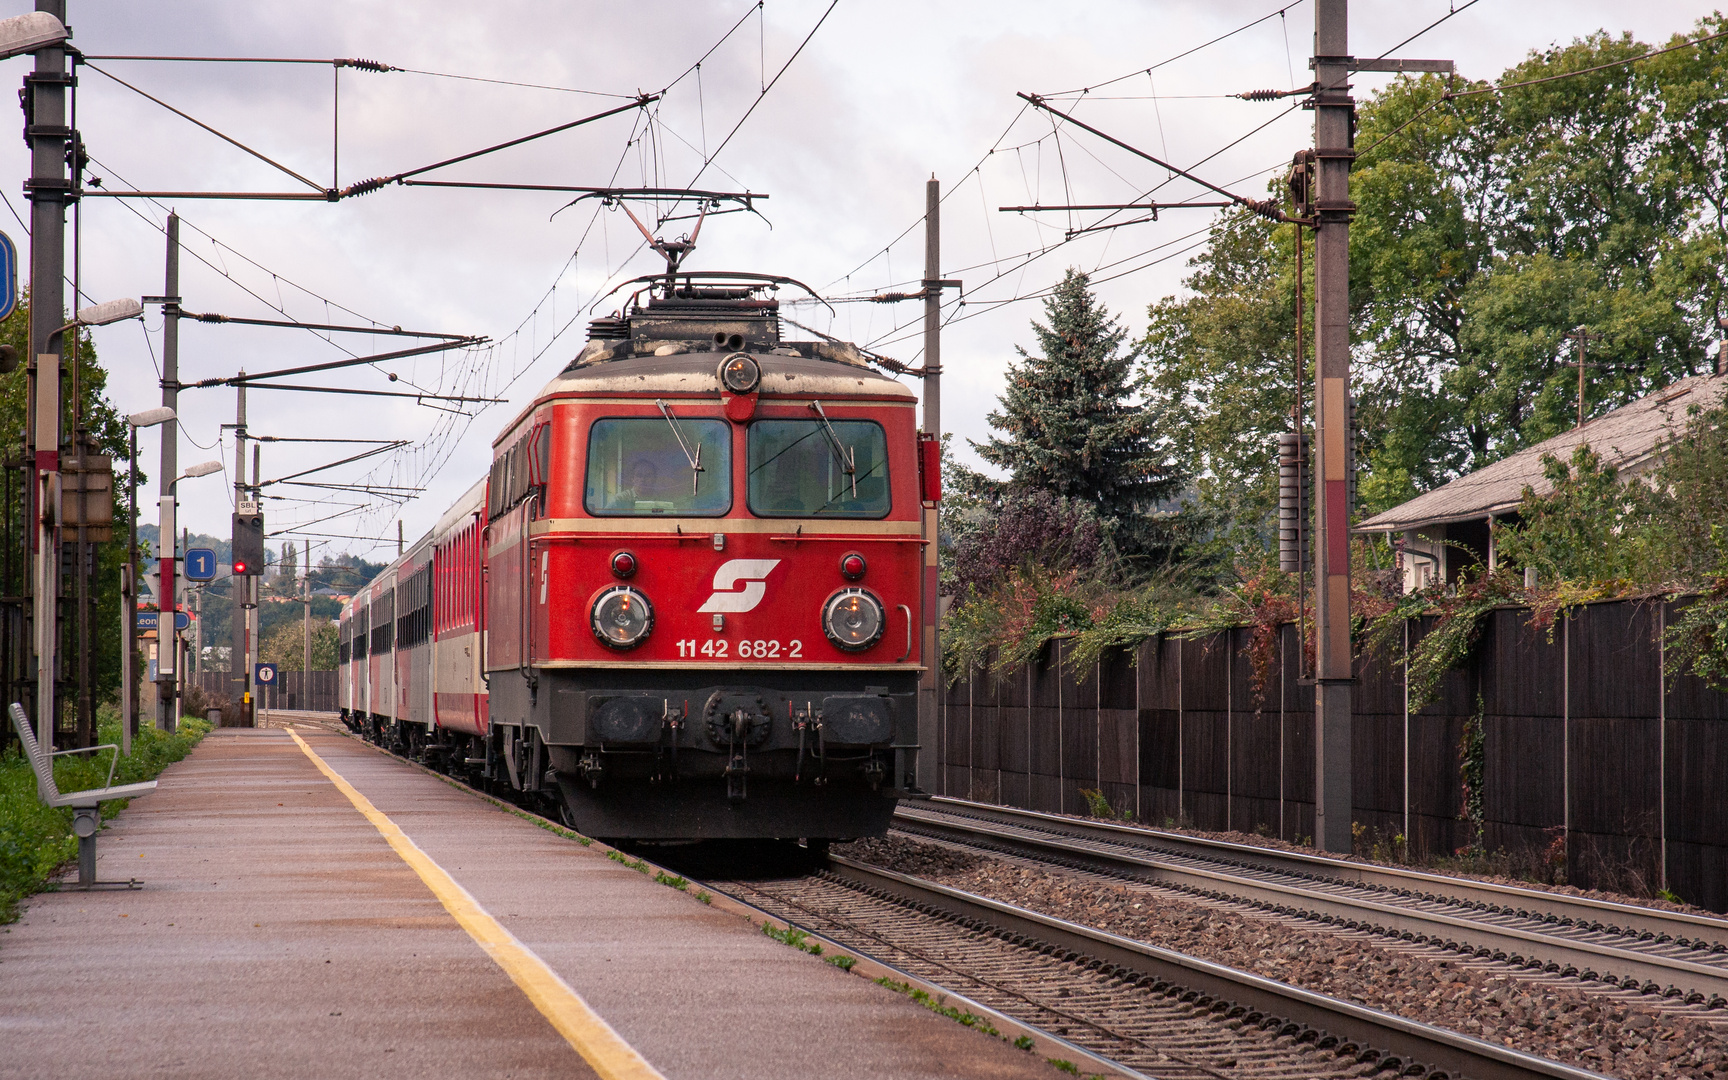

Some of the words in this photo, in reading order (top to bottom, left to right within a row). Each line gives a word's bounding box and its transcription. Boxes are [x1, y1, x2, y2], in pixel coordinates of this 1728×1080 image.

[197, 556, 205, 573] 1
[676, 639, 729, 658] 1142
[738, 639, 803, 658] 682-2
